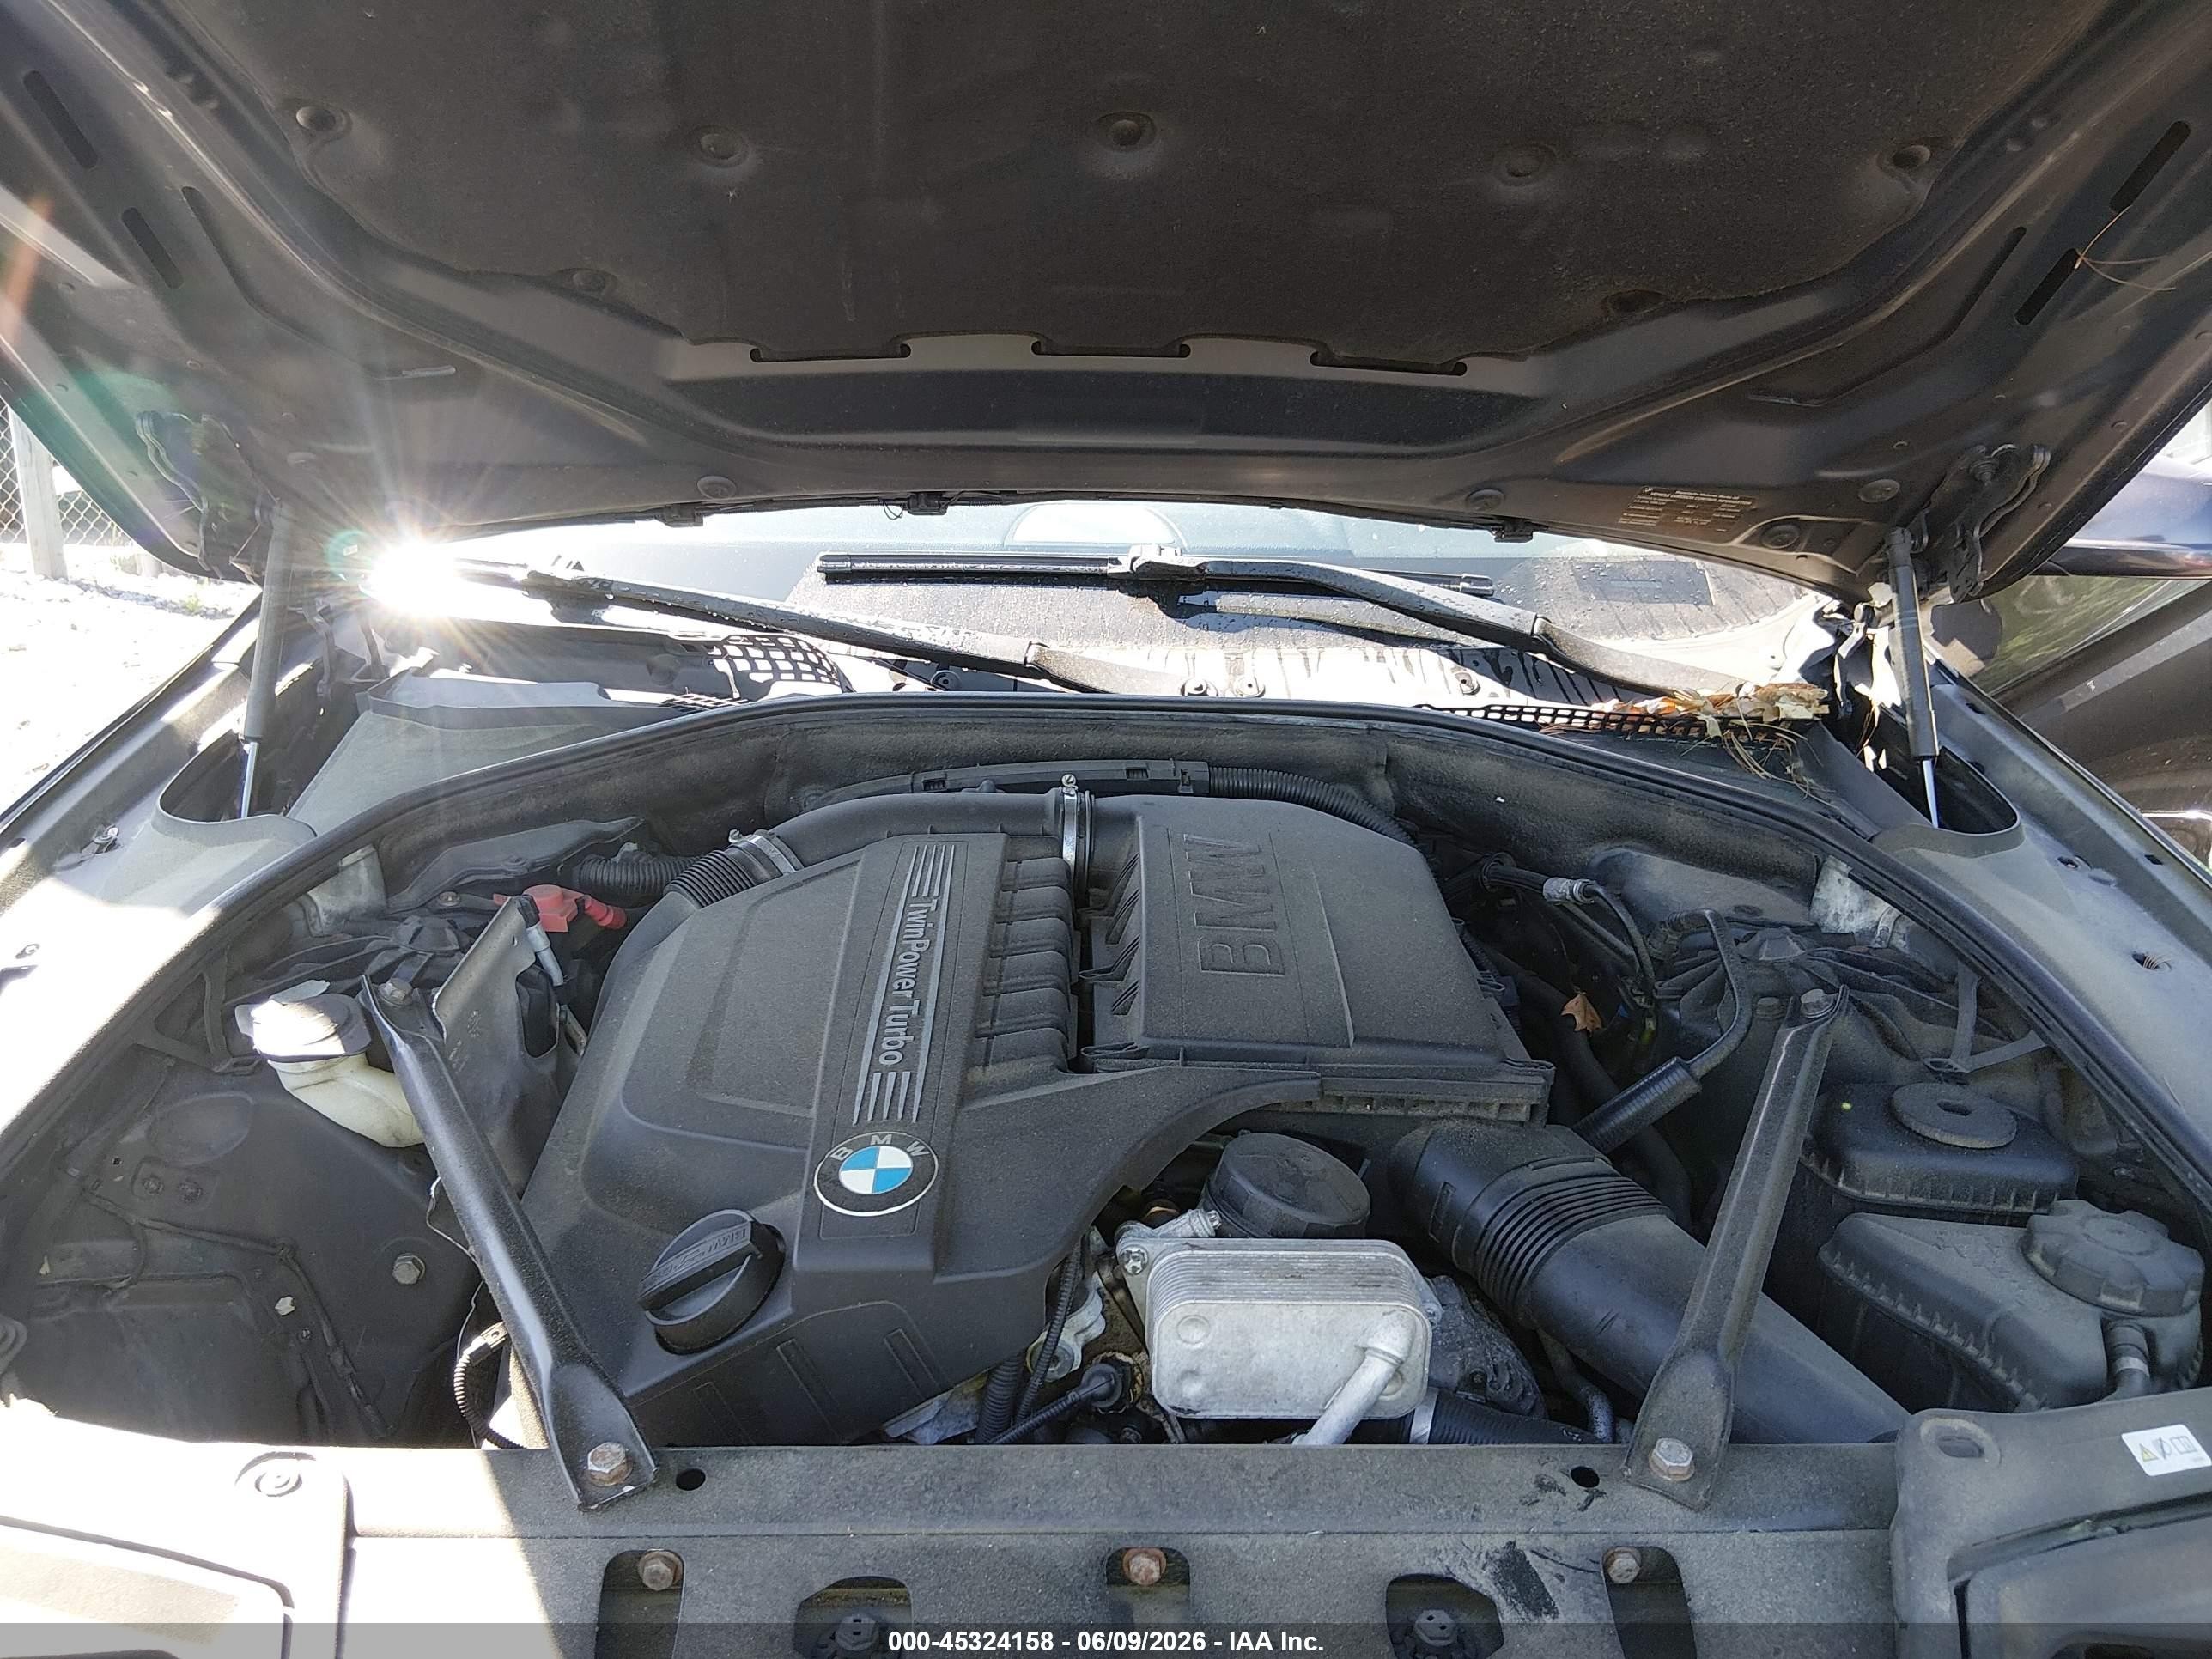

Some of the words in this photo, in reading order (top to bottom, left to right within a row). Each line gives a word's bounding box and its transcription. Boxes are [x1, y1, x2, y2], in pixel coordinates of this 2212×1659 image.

[1182, 832, 1285, 977] BMW
[892, 898, 939, 998] TwinPower
[878, 1000, 921, 1066] Turbo
[830, 1133, 931, 1162] BMW
